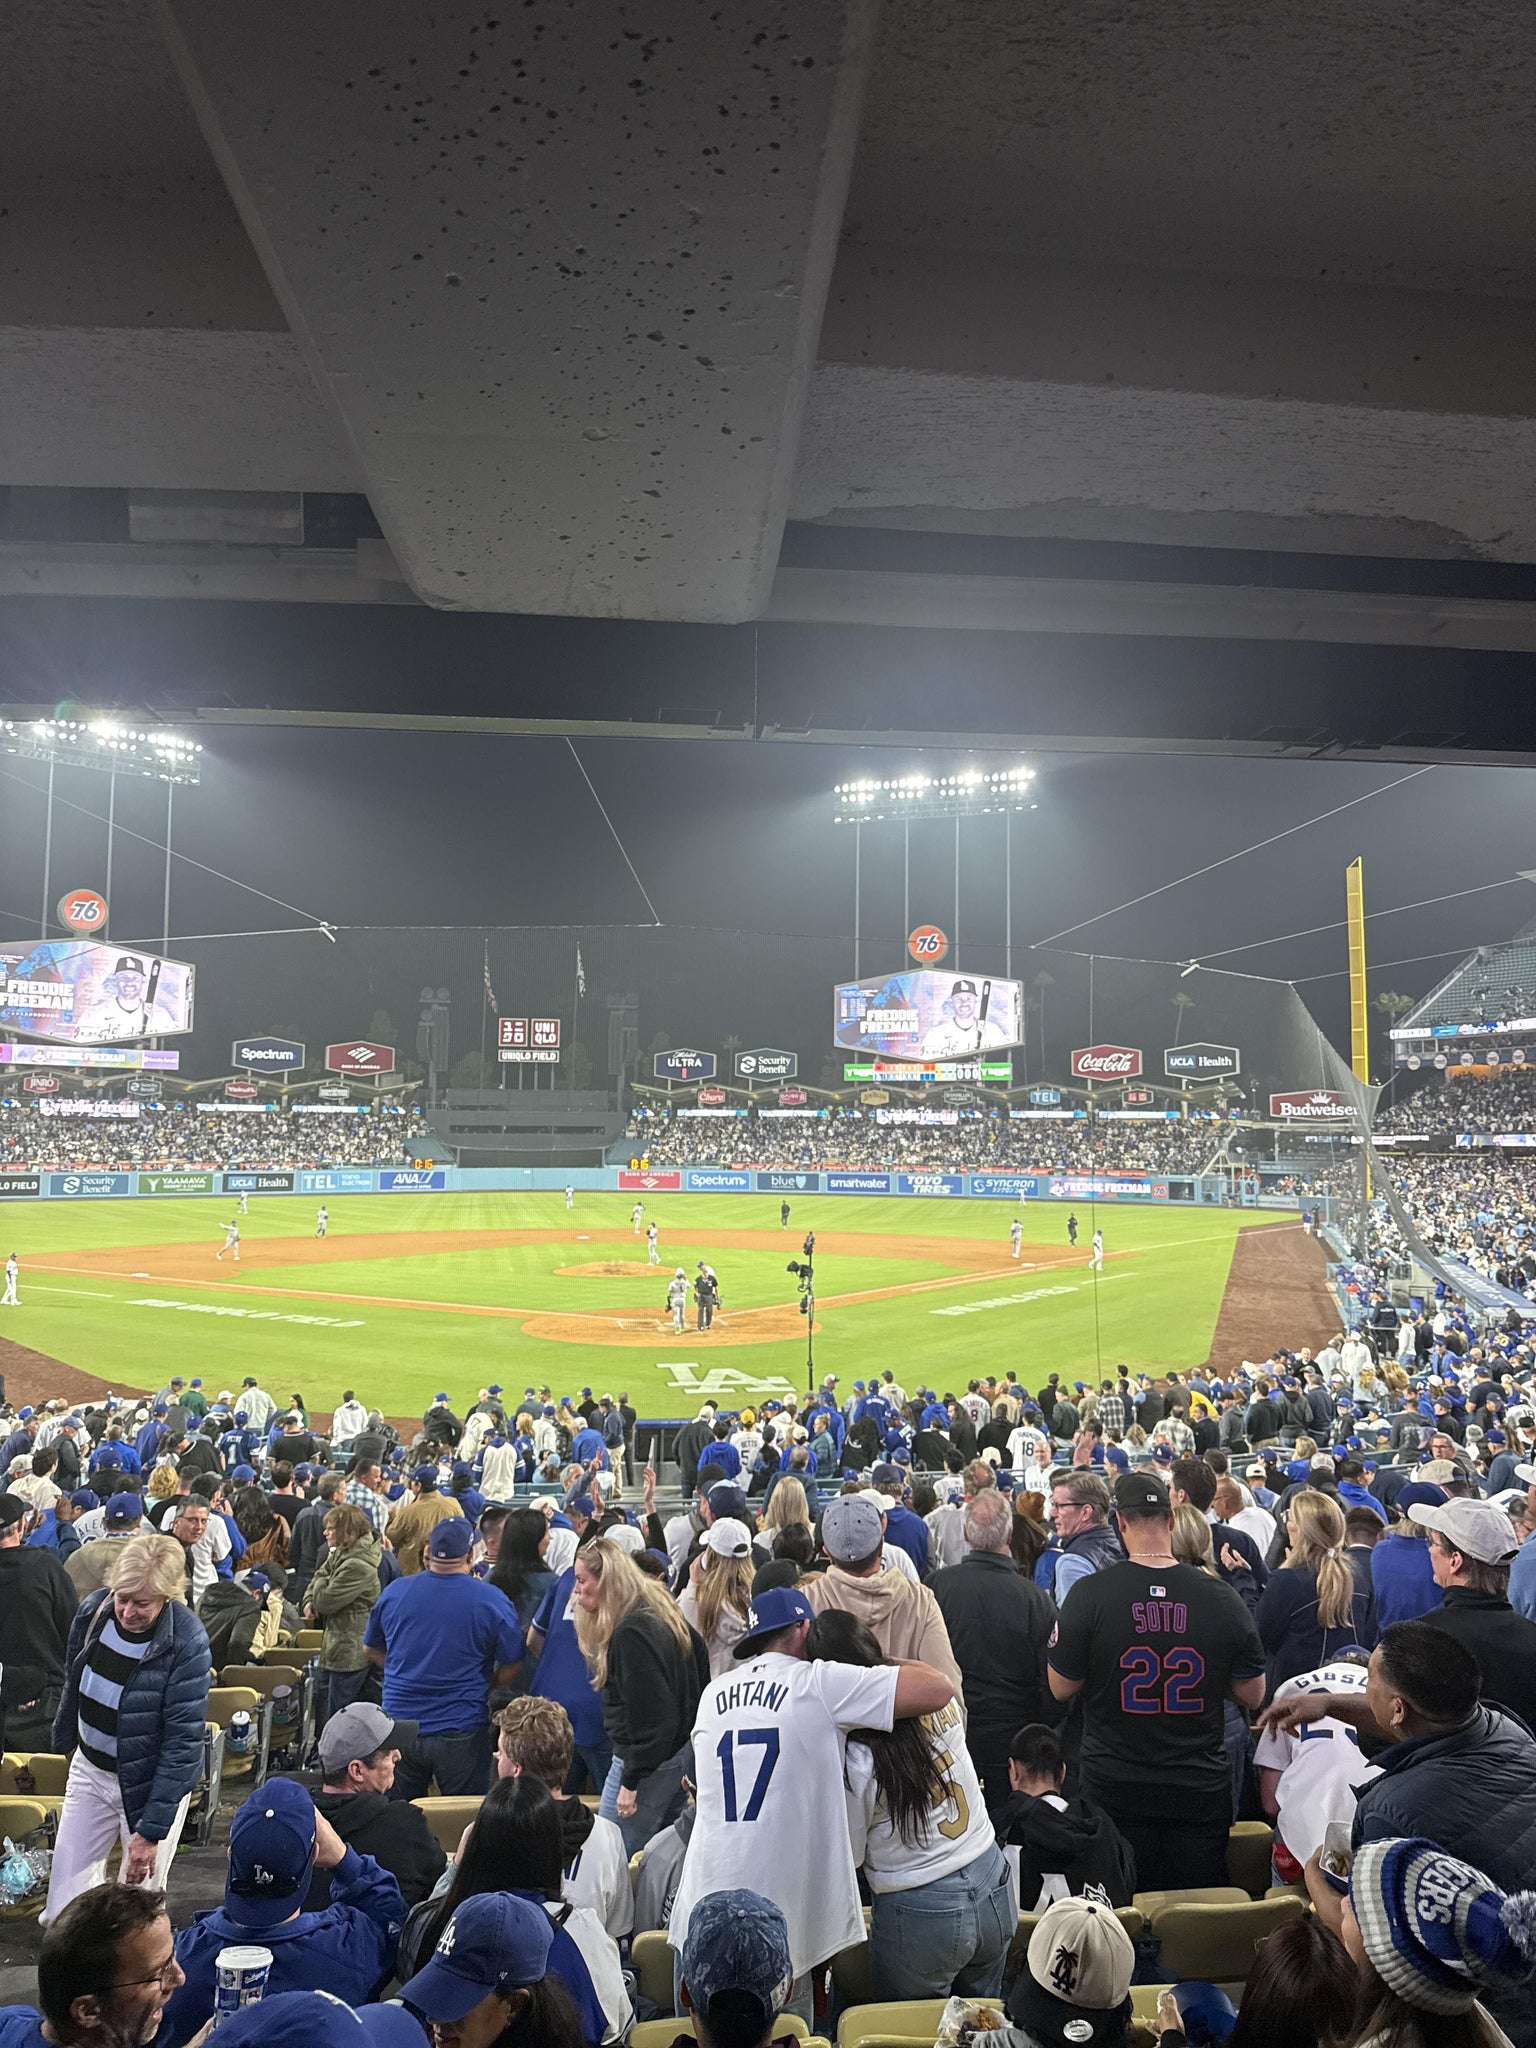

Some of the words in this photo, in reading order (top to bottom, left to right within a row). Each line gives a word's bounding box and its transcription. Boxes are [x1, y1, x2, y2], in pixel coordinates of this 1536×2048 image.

[70, 900, 101, 922] 76
[916, 934, 939, 953] 76
[7, 980, 74, 997] FREDDIE
[0, 993, 74, 1010] FREEMAN
[63, 1011, 74, 1022] 5
[866, 1009, 919, 1022] FREDDIE
[534, 1022, 556, 1033] UNI
[860, 1020, 919, 1034] FREEMAN
[534, 1032, 557, 1045] QLO
[911, 1033, 919, 1043] 5
[241, 1047, 294, 1061] Spectrum
[501, 1051, 532, 1062] UNIQLO
[532, 1052, 557, 1061] FIELD
[667, 1058, 703, 1068] ULTRA
[758, 1056, 791, 1067] Security
[1078, 1052, 1134, 1073] Coca-Cola
[1170, 1057, 1195, 1067] UCLA
[1198, 1056, 1233, 1067] Health
[758, 1065, 787, 1074] Benefit
[30, 1078, 54, 1088] JINRO
[699, 1092, 725, 1102] Churu
[1034, 1092, 1057, 1102] TEL
[82, 1176, 116, 1187] Security
[231, 1179, 253, 1187] UCLA
[257, 1177, 289, 1187] Health
[303, 1175, 336, 1190] TEL
[393, 1173, 419, 1184] ANA
[691, 1174, 742, 1187] Spectrum
[771, 1175, 795, 1186] blue
[830, 1178, 888, 1190] smartwater
[907, 1176, 943, 1185] TOYO
[985, 1177, 1035, 1188] SYNCRON
[11, 1181, 38, 1191] FIELD
[82, 1184, 112, 1194] Benefit
[912, 1184, 952, 1194] TIRES
[1064, 1182, 1104, 1192] FREDDIE
[1105, 1182, 1150, 1193] FREEMAN
[1154, 1187, 1165, 1195] 76
[656, 1362, 797, 1394] LA
[970, 1408, 978, 1422] 8
[228, 1444, 236, 1464] 1
[1021, 1441, 1034, 1456] 18
[1132, 1601, 1187, 1634] SOTO
[1120, 1645, 1205, 1715] 22
[716, 1680, 789, 1716] OHTANI
[717, 1727, 780, 1822] 17
[929, 1749, 970, 1840] 5
[254, 1864, 273, 1885] LA
[437, 1916, 457, 1956] LA
